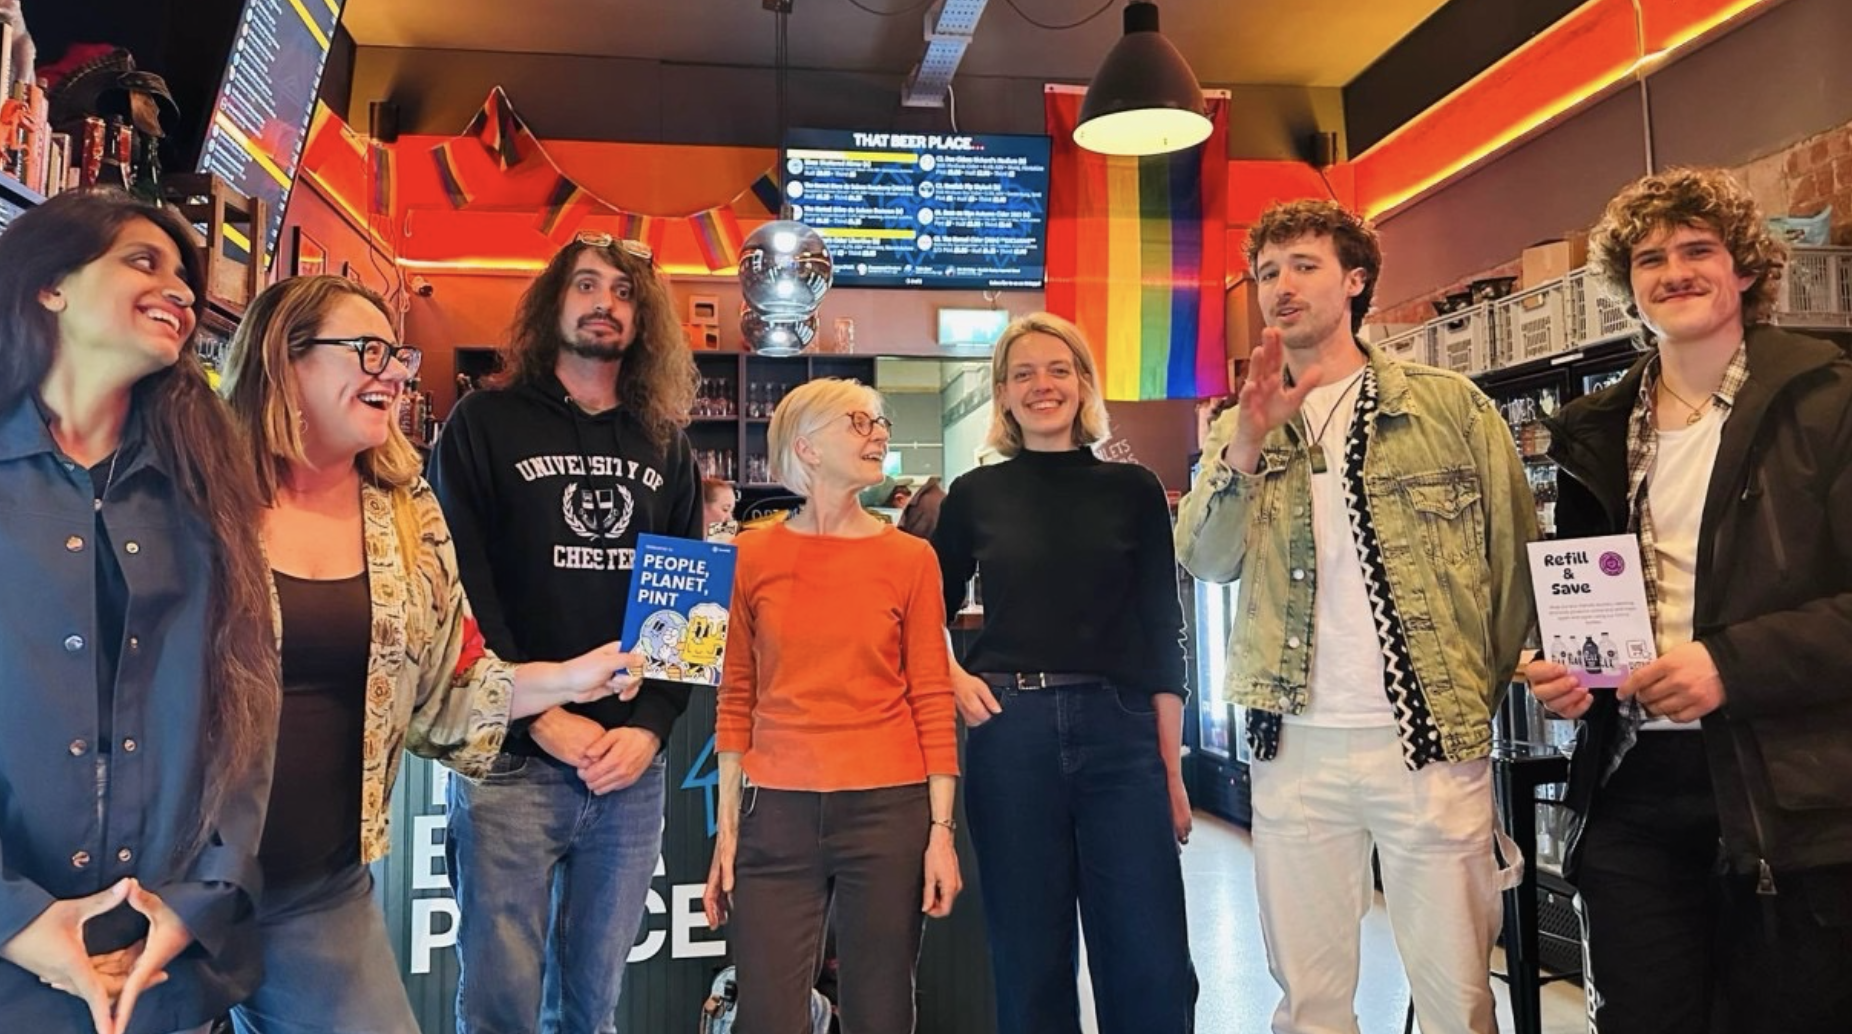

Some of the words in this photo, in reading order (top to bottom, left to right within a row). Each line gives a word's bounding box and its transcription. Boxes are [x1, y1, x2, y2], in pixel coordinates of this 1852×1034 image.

[853, 133, 890, 147] THAT
[890, 134, 927, 149] BEER
[643, 553, 710, 579] PEOPLE,
[1544, 551, 1590, 567] Refill
[1563, 567, 1575, 580] &
[640, 571, 709, 597] PLANET,
[637, 588, 680, 608] PINT
